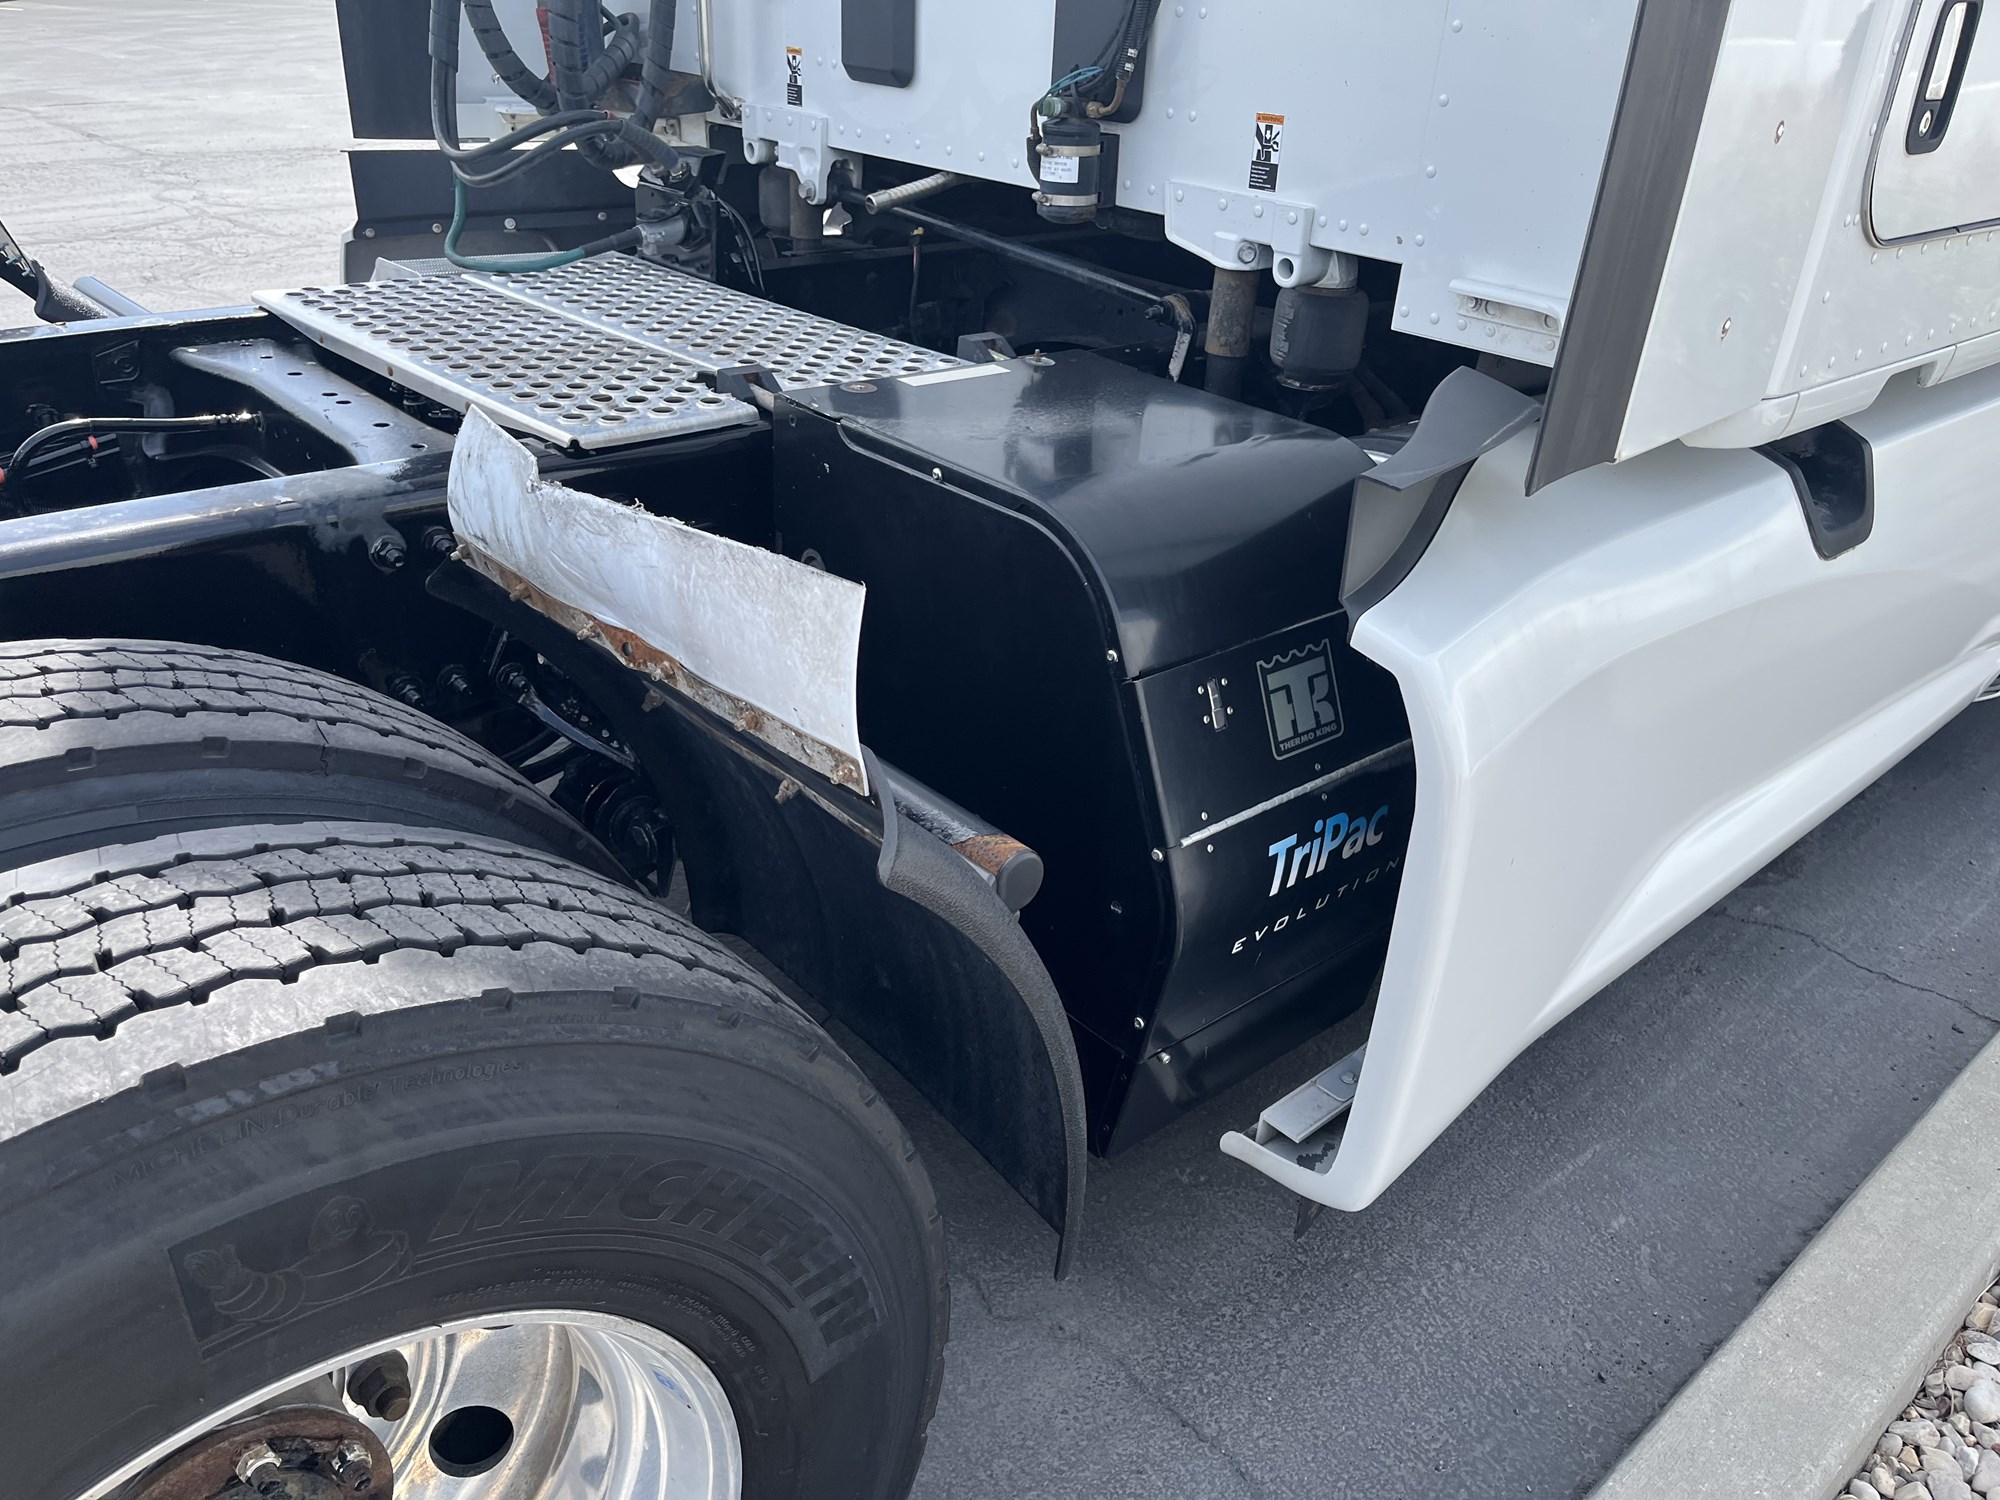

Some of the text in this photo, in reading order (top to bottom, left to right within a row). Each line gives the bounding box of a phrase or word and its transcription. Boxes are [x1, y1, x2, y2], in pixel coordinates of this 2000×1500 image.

[1279, 722, 1338, 752] THERMO KING
[1268, 804, 1389, 898] TriPac
[1231, 856, 1402, 955] EVOLUTION
[109, 1114, 267, 1191] MICHELIN
[391, 1061, 522, 1094] Technologies
[427, 1152, 878, 1347] MICHELIN
